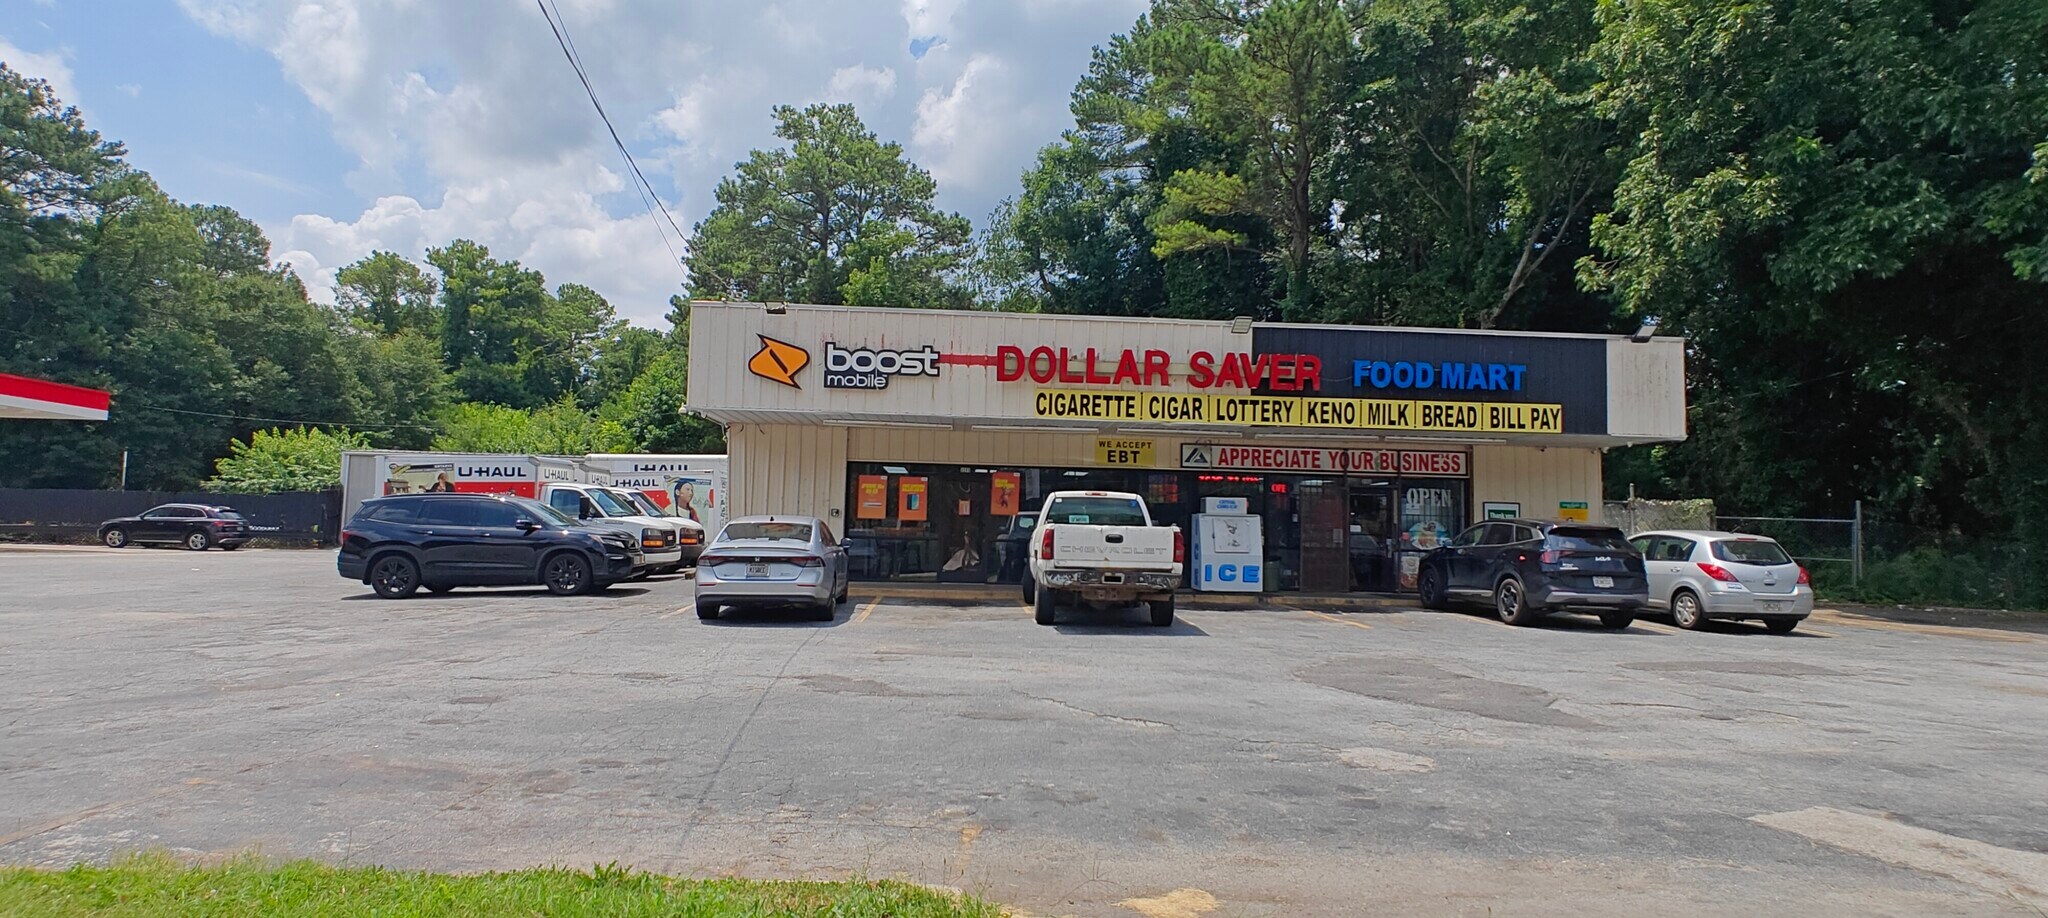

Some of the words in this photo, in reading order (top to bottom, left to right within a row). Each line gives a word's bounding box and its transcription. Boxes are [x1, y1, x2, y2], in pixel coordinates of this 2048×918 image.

[826, 343, 939, 376] boost
[997, 346, 1171, 387] DOLLAR
[1187, 351, 1322, 391] SAVER
[827, 373, 888, 389] mobile
[1353, 359, 1435, 389] FOOD
[1441, 362, 1527, 392] MART
[1036, 392, 1136, 418] CIGARETTE
[1149, 396, 1203, 420] CIGAR
[1216, 398, 1294, 422] LOTTERY
[1307, 401, 1356, 425] KENO
[1367, 403, 1409, 426] MILK
[1422, 404, 1477, 428] BREAD
[1490, 406, 1526, 429] BILL
[1530, 408, 1561, 430] PAY
[1098, 440, 1112, 448] WE
[1116, 441, 1152, 449] ACCEPT
[1107, 450, 1141, 464] EBT
[1218, 448, 1321, 468] APPRECIATE
[1328, 451, 1374, 470] YOUR
[1380, 453, 1461, 473] BUSINESS
[458, 467, 527, 477] U-HAUL
[544, 469, 569, 481] U-HAUL
[1406, 488, 1452, 508] OPEN
[1060, 545, 1168, 555] CHEVROLET
[1204, 563, 1260, 583] ICE
